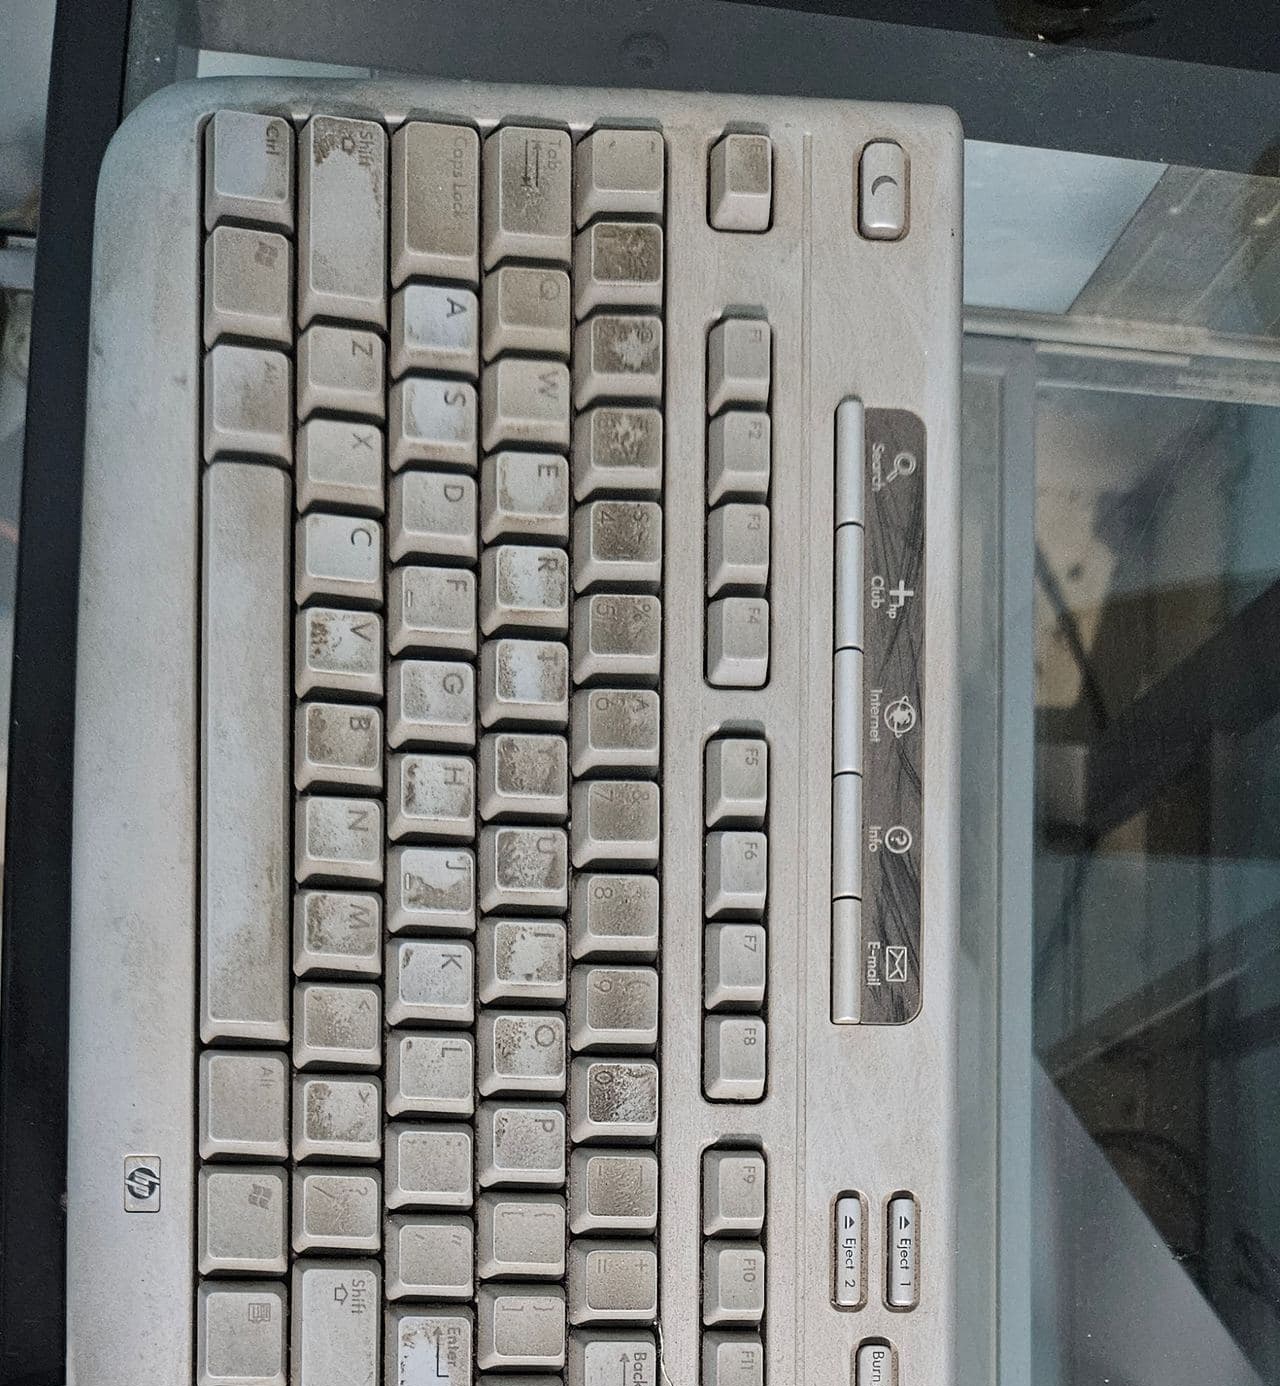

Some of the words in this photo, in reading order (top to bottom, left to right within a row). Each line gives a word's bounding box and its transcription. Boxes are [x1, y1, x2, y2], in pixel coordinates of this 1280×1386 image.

[266, 125, 279, 156] Ctrl
[453, 137, 468, 178] Caps
[547, 139, 561, 171] Tab
[540, 279, 560, 300] Q
[446, 298, 467, 318] A
[352, 340, 373, 359] Z
[538, 370, 559, 400] W
[444, 390, 466, 407] S
[749, 421, 762, 439] F2
[353, 432, 373, 450] X
[538, 464, 559, 478] E
[872, 442, 885, 492] Search
[444, 484, 464, 502] D
[747, 513, 761, 530] F3
[351, 528, 372, 547] C
[538, 557, 559, 572] R
[446, 579, 467, 592] F
[871, 575, 885, 609] Club
[596, 603, 616, 617] 5
[633, 603, 652, 621] %
[748, 607, 760, 624] F4
[886, 603, 901, 619] hp
[350, 622, 371, 642] V
[443, 673, 464, 695] G
[350, 716, 371, 731] B
[870, 689, 883, 743] Internet
[745, 747, 759, 766] F5
[444, 767, 465, 786] H
[594, 789, 614, 802] 7
[348, 810, 369, 831] N
[537, 836, 557, 853] U
[869, 826, 881, 852] Info
[744, 842, 758, 860] F6
[445, 860, 466, 870] J
[594, 886, 613, 899] 8
[349, 903, 370, 929] M
[744, 934, 757, 952] F7
[441, 953, 462, 970] K
[866, 941, 881, 986] E-mail
[593, 979, 613, 992] 9
[534, 1024, 556, 1047] O
[744, 1027, 757, 1046] F8
[441, 1047, 463, 1057] L
[260, 1066, 275, 1089] Alt
[534, 1118, 555, 1132] P
[743, 1166, 756, 1184] F9
[842, 1238, 856, 1270] Eject
[897, 1238, 911, 1270] Eject
[743, 1258, 756, 1283] F10
[844, 1280, 856, 1288] 2
[352, 1278, 366, 1314] Shift
[447, 1326, 461, 1368] Enter
[741, 1350, 754, 1370] F11
[872, 1351, 885, 1382] Burn
